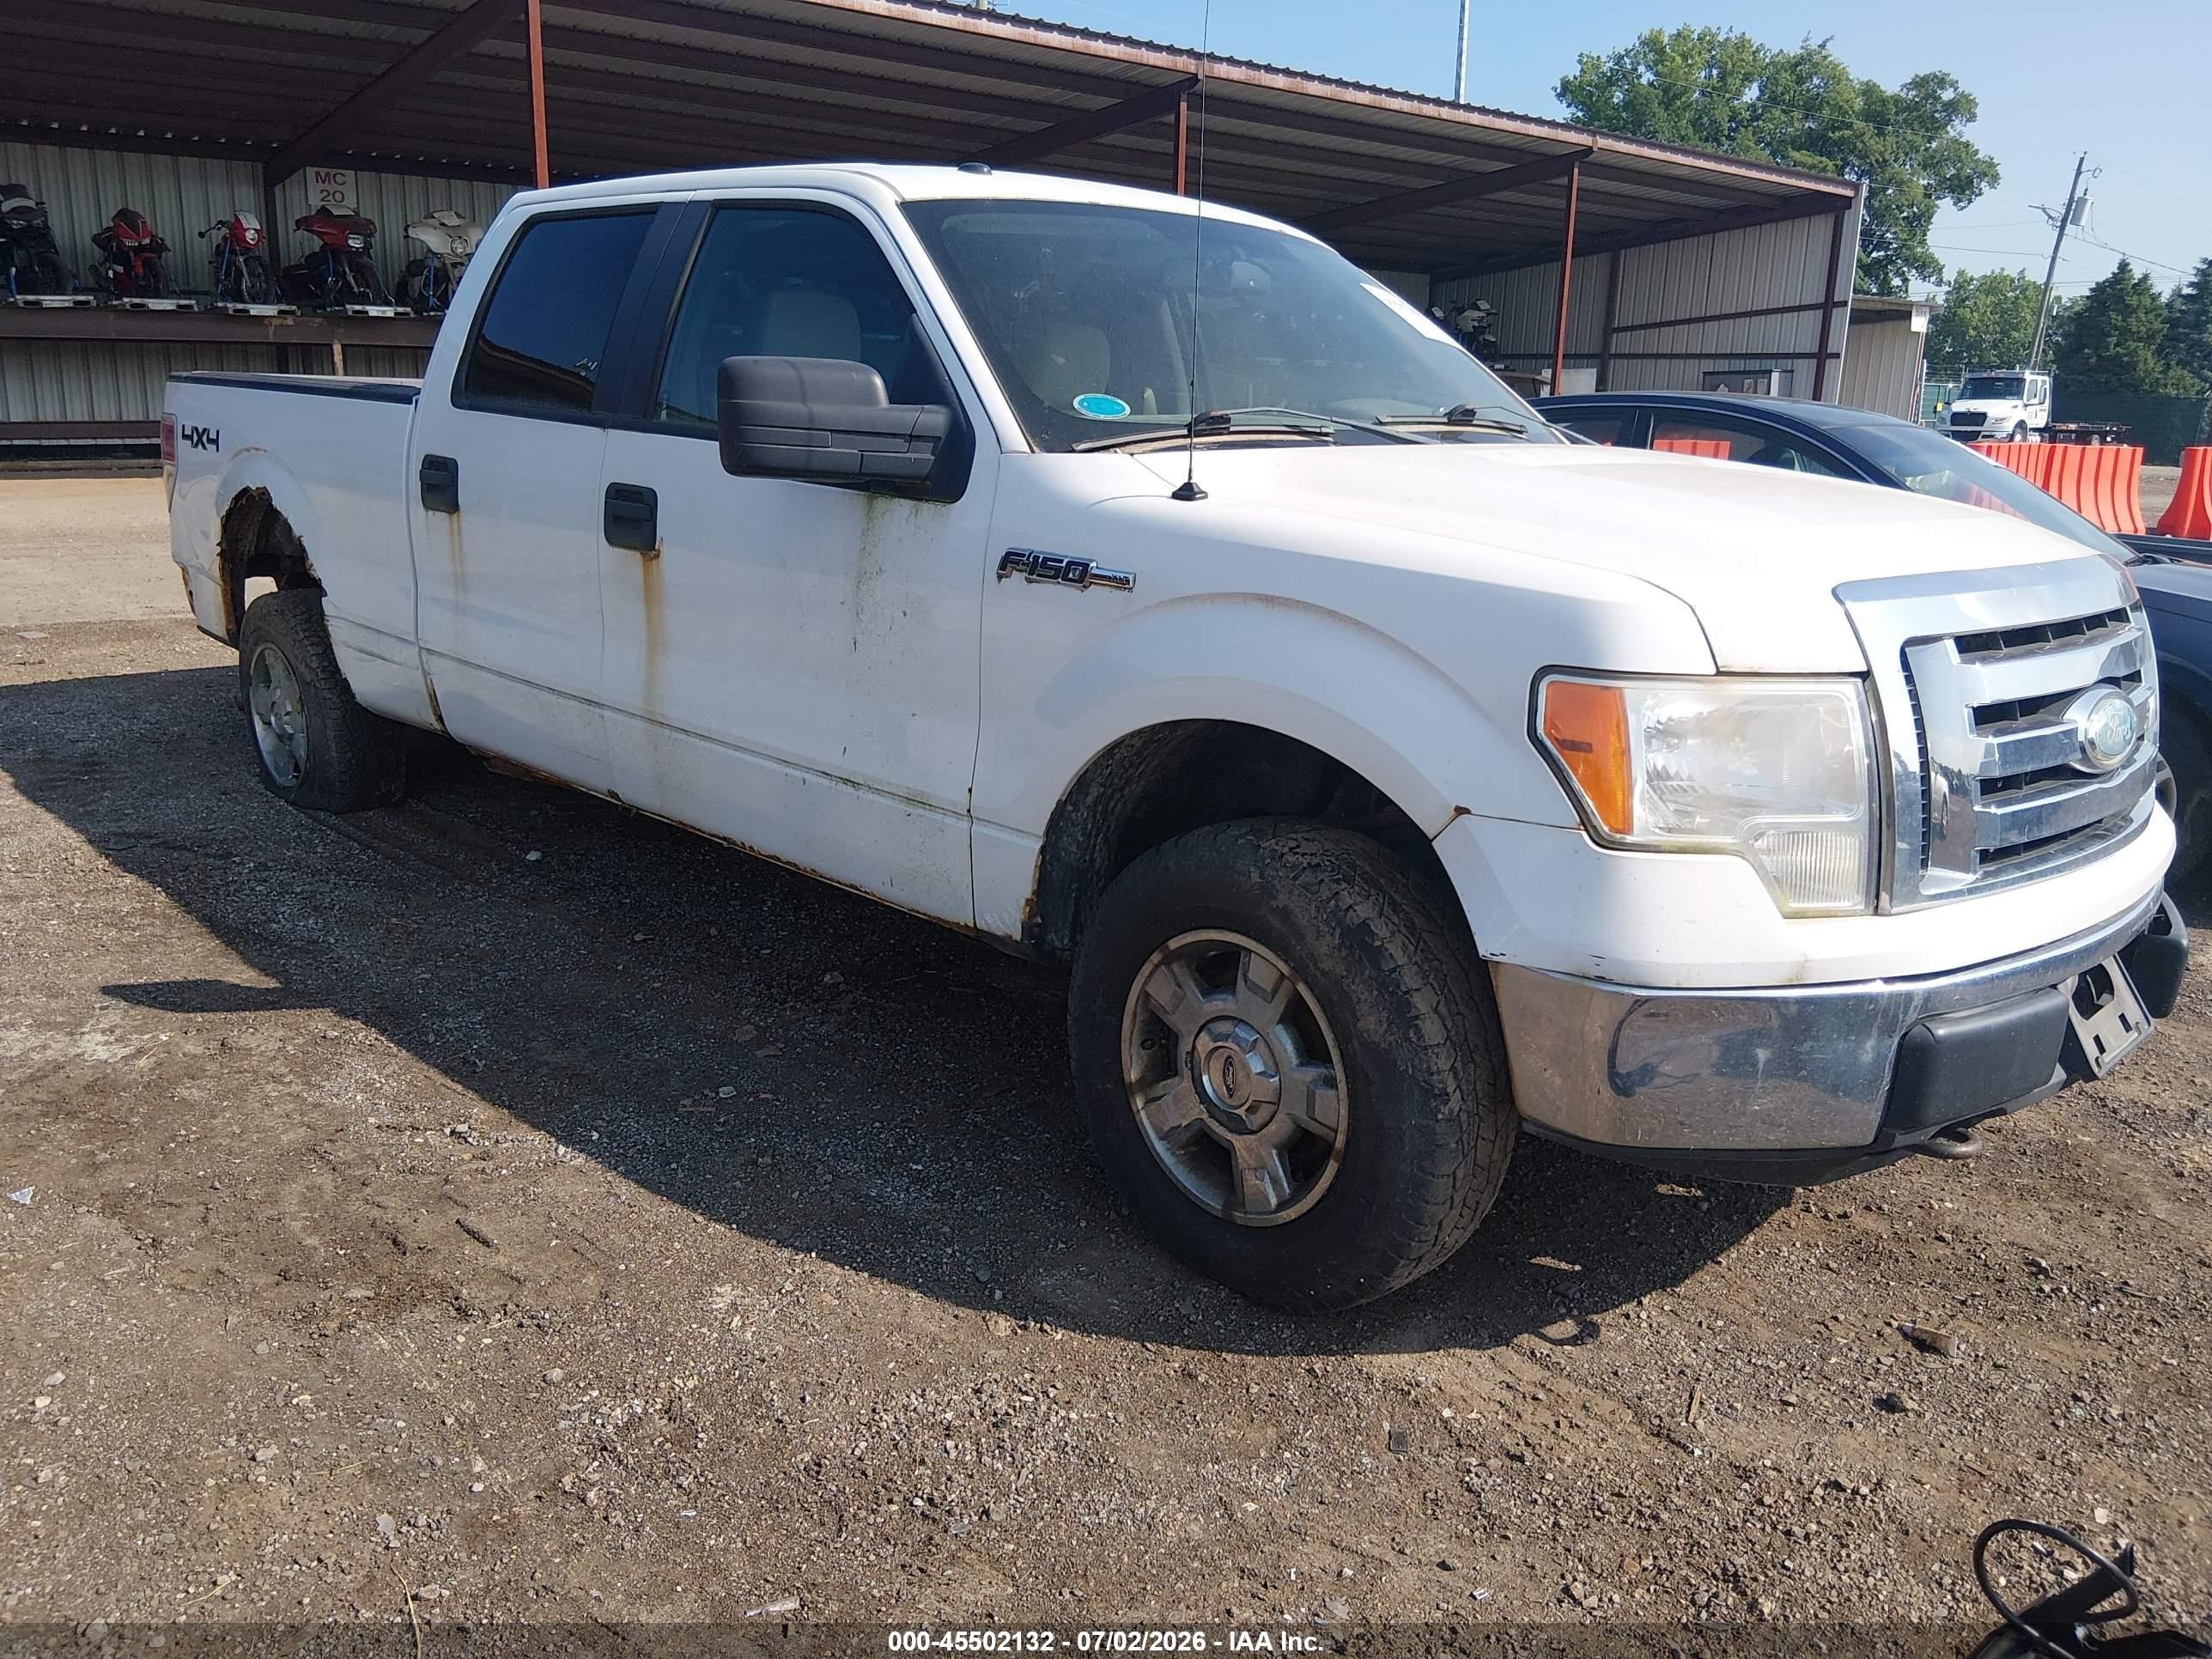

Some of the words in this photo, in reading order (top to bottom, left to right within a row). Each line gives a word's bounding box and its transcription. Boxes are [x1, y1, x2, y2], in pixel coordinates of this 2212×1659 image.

[315, 171, 347, 185] MC
[320, 189, 345, 204] 20
[999, 550, 1091, 586] F-150
